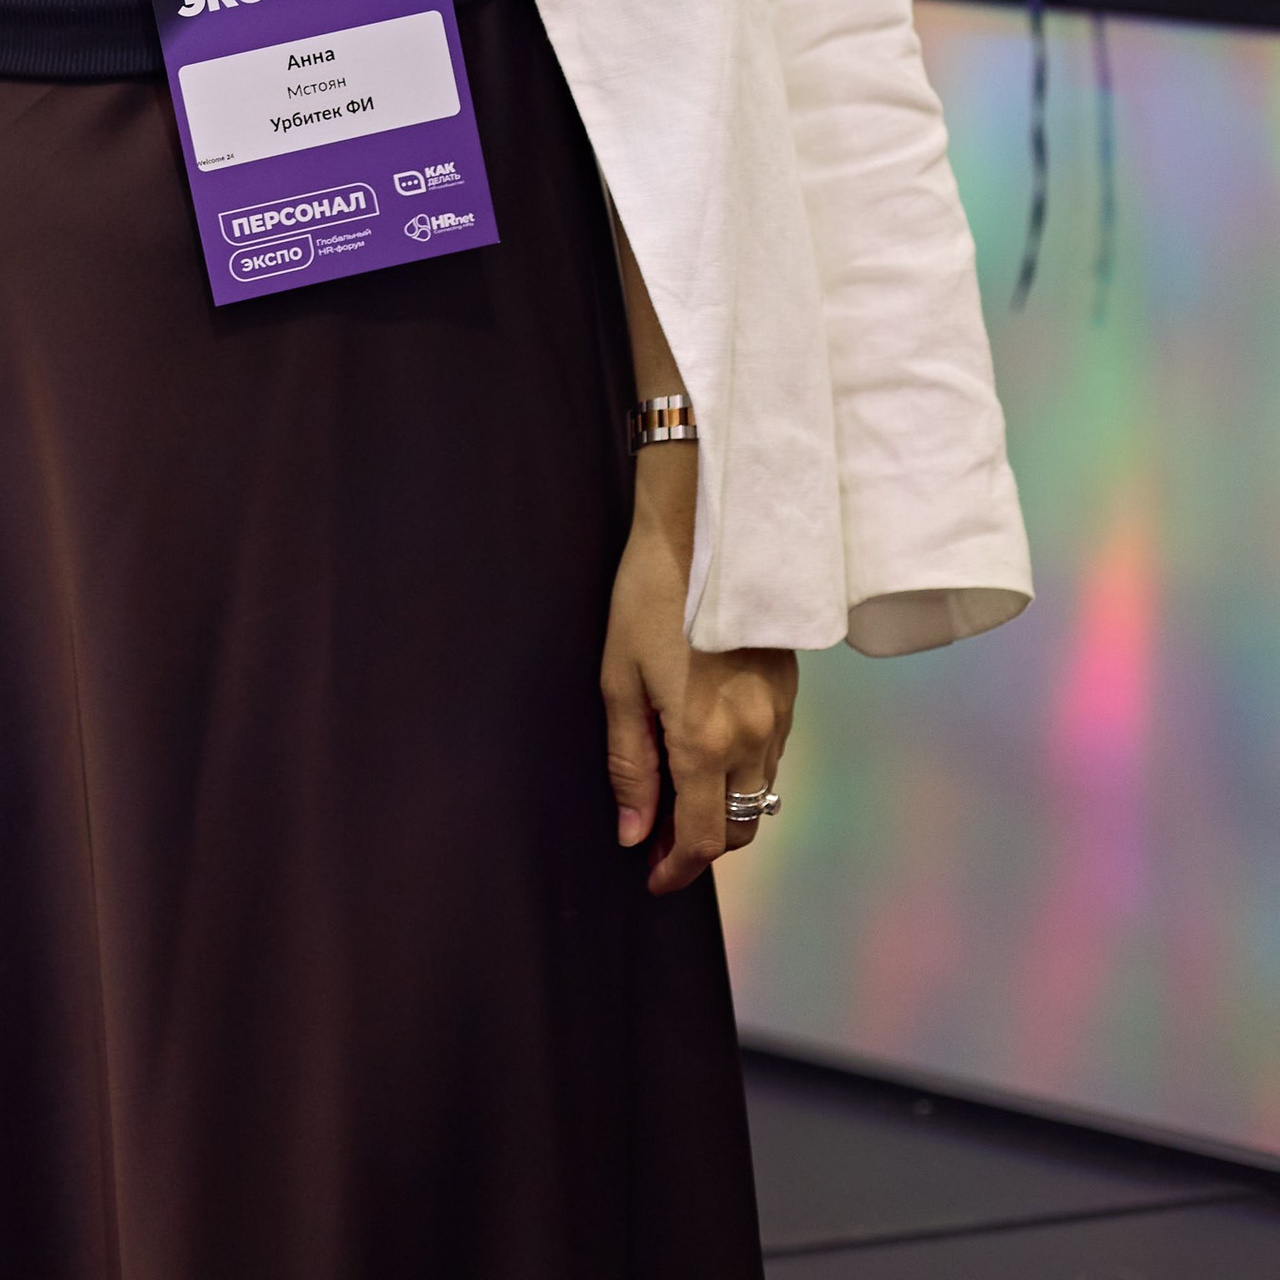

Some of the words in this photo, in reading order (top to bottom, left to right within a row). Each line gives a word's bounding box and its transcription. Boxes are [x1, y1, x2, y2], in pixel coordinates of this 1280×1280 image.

[287, 49, 336, 71] Анна
[287, 77, 347, 99] Мстоян
[270, 106, 343, 133] Урбитек
[346, 96, 375, 115] ФИ
[424, 162, 456, 178] КАК
[427, 173, 461, 187] ДЕЛАТЬ
[232, 191, 367, 237] ПЕРСОНАЛ
[430, 213, 475, 230] HRnet
[317, 228, 372, 246] Глобальный
[318, 240, 365, 256] HR-форум
[240, 247, 303, 272] ЭКСПО
